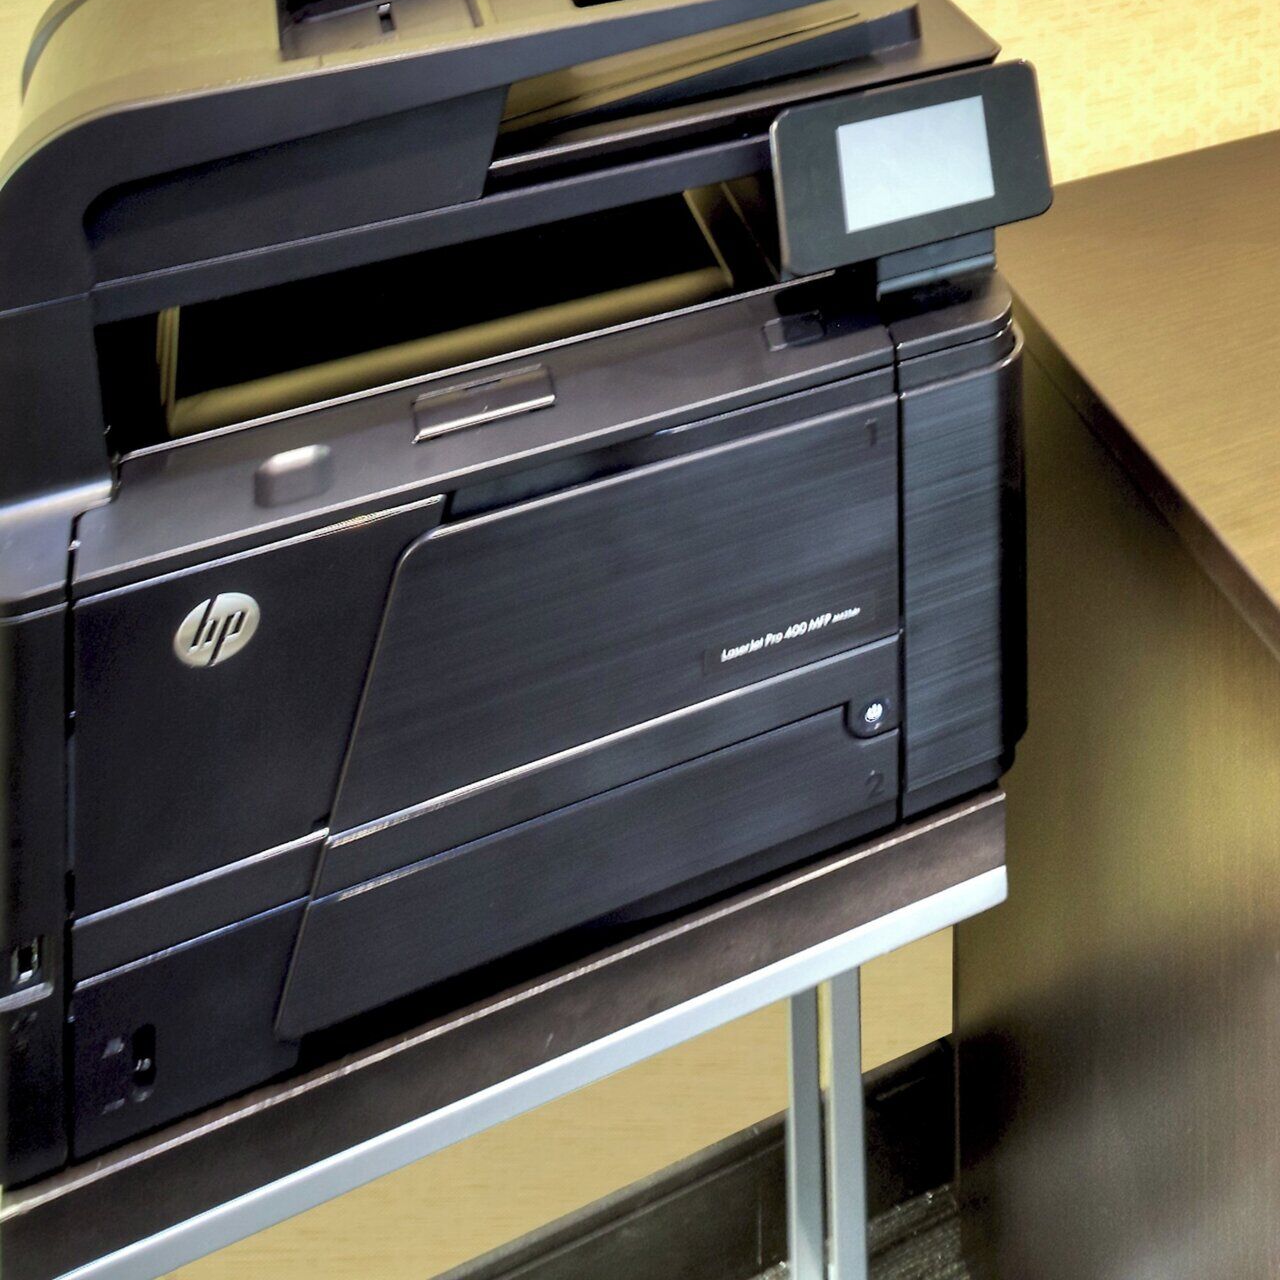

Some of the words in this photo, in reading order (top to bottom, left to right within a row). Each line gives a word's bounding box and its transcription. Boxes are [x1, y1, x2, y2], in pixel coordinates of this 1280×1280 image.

[720, 637, 764, 662] LaserJet
[764, 632, 783, 648] Pro
[784, 621, 808, 639] 400
[808, 612, 832, 632] MFP
